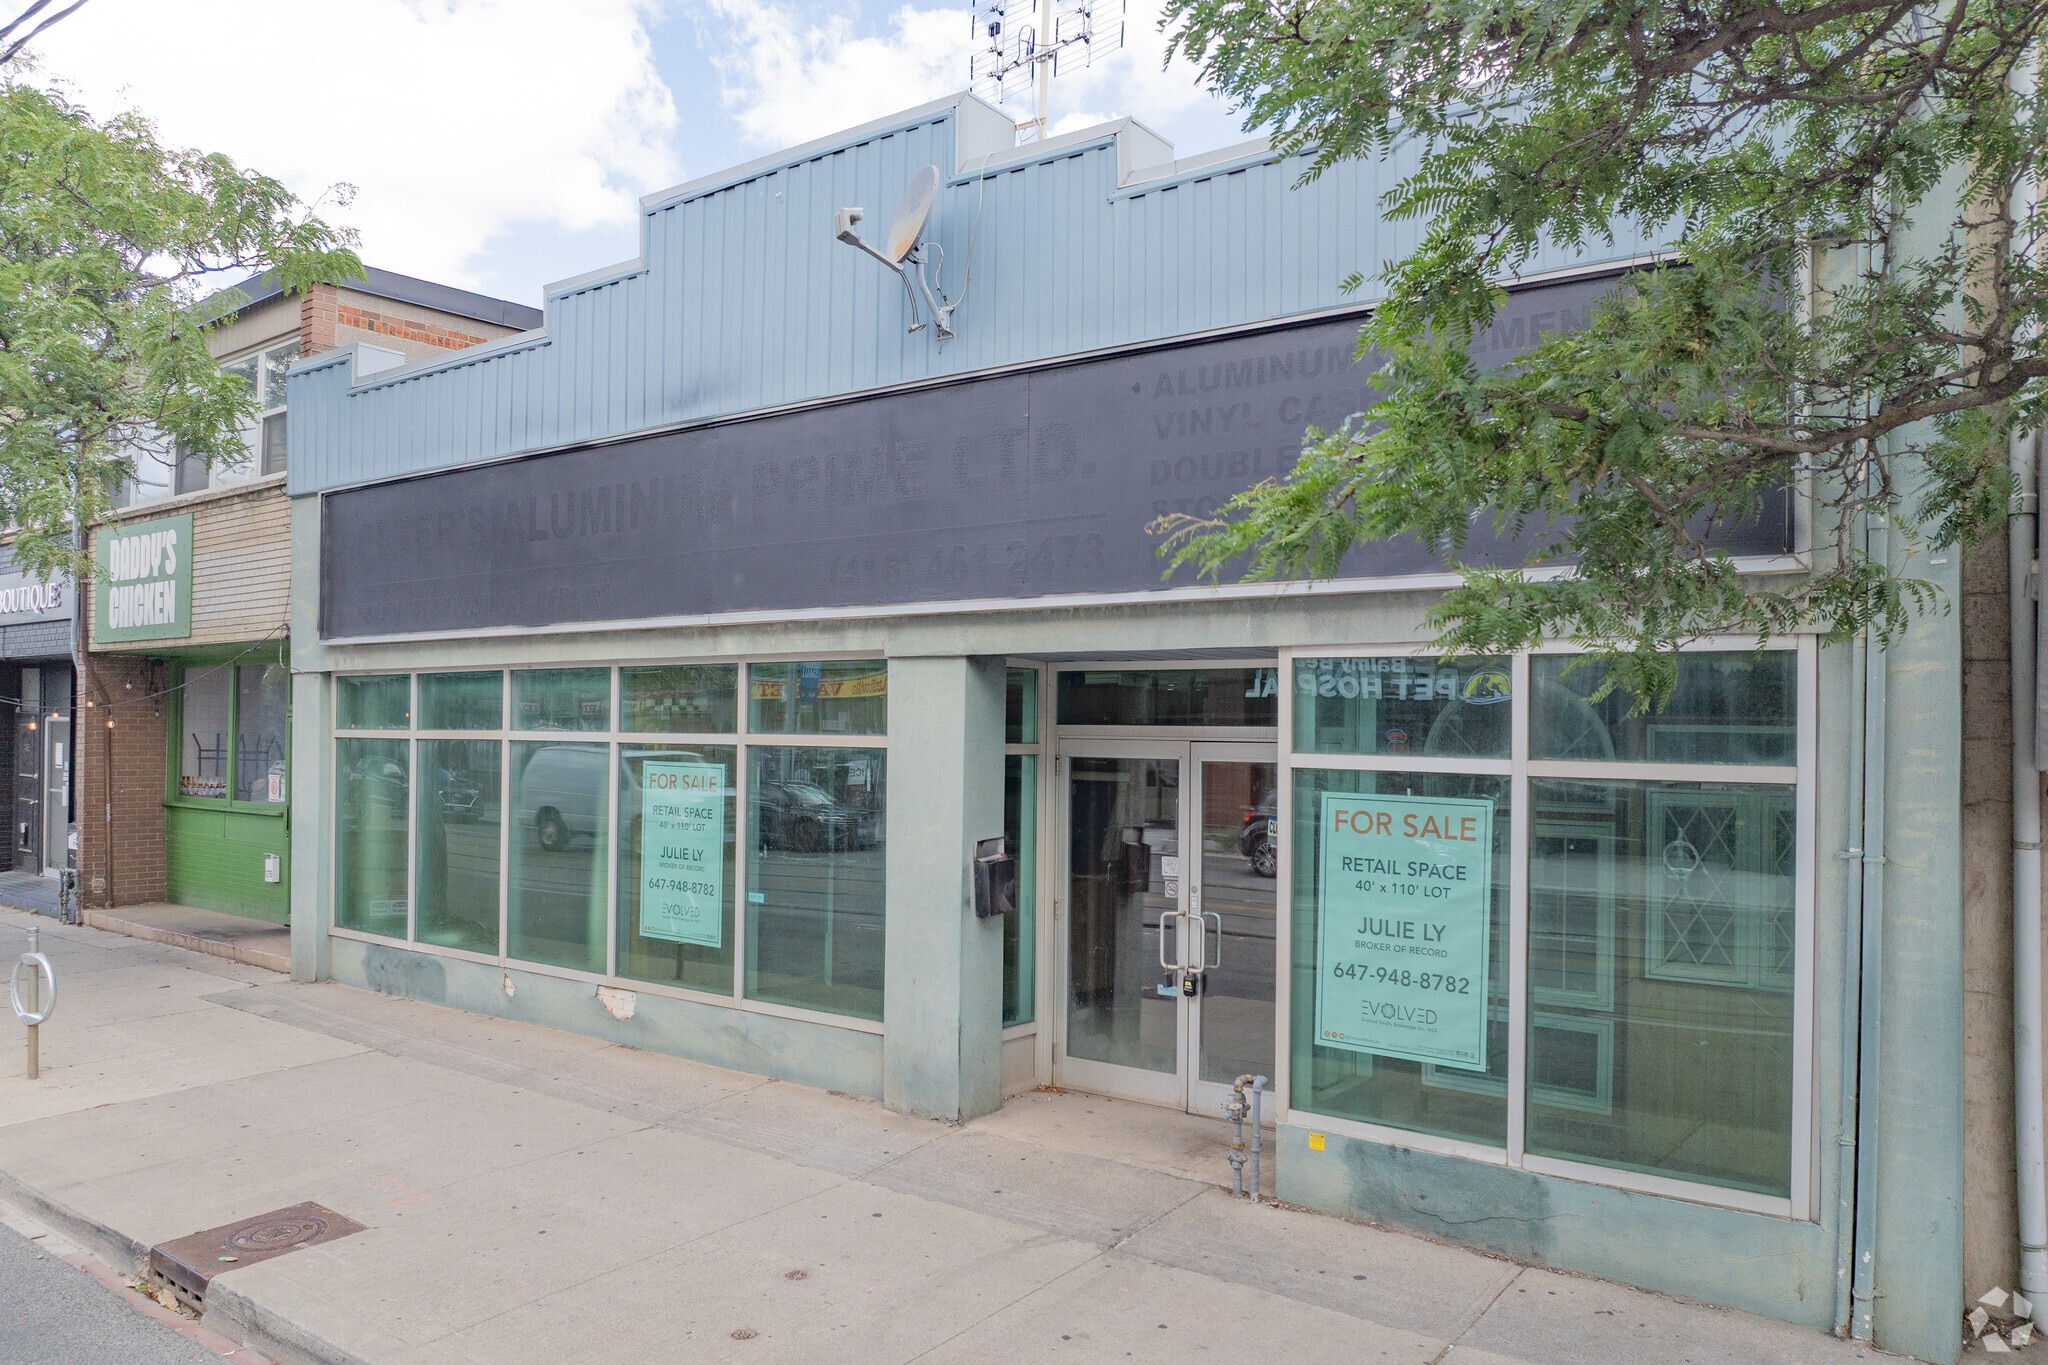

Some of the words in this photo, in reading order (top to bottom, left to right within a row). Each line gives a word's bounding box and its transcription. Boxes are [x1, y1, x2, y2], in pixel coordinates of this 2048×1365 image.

[1152, 342, 1359, 399] ALUMINUM
[1154, 402, 1260, 440] VINYL
[752, 438, 929, 505] PRIME
[954, 420, 1097, 491] LTD.
[1150, 444, 1298, 486] DOUBLE
[110, 529, 177, 582] DADDY'S
[109, 580, 176, 629] CHICKEN
[649, 773, 678, 790] FOR
[682, 774, 717, 792] SALE
[652, 805, 682, 817] RETAIL
[684, 807, 713, 819] SPACE
[692, 823, 706, 831] LOT
[1334, 810, 1392, 836] FOR
[1403, 813, 1477, 842] SALE
[660, 846, 689, 860] JULIE
[692, 849, 704, 861] LY
[659, 862, 677, 870] BROKER
[1342, 856, 1401, 876] RETAIL
[1407, 861, 1467, 881] SPACE
[648, 877, 715, 896] 647-948-8782
[1355, 879, 1375, 892] 40'
[1379, 884, 1387, 893] x
[1391, 883, 1420, 896] 110'
[1423, 886, 1452, 899] LOT
[661, 903, 701, 918] EVOLVED
[1357, 917, 1415, 940] JULIE
[1423, 923, 1447, 942] LY
[1355, 940, 1391, 952] BROKER
[1393, 945, 1407, 953] OF
[1409, 946, 1448, 958] RECORD
[1333, 961, 1470, 995] 647-948-8782
[1361, 1000, 1438, 1024] EVOLVED
